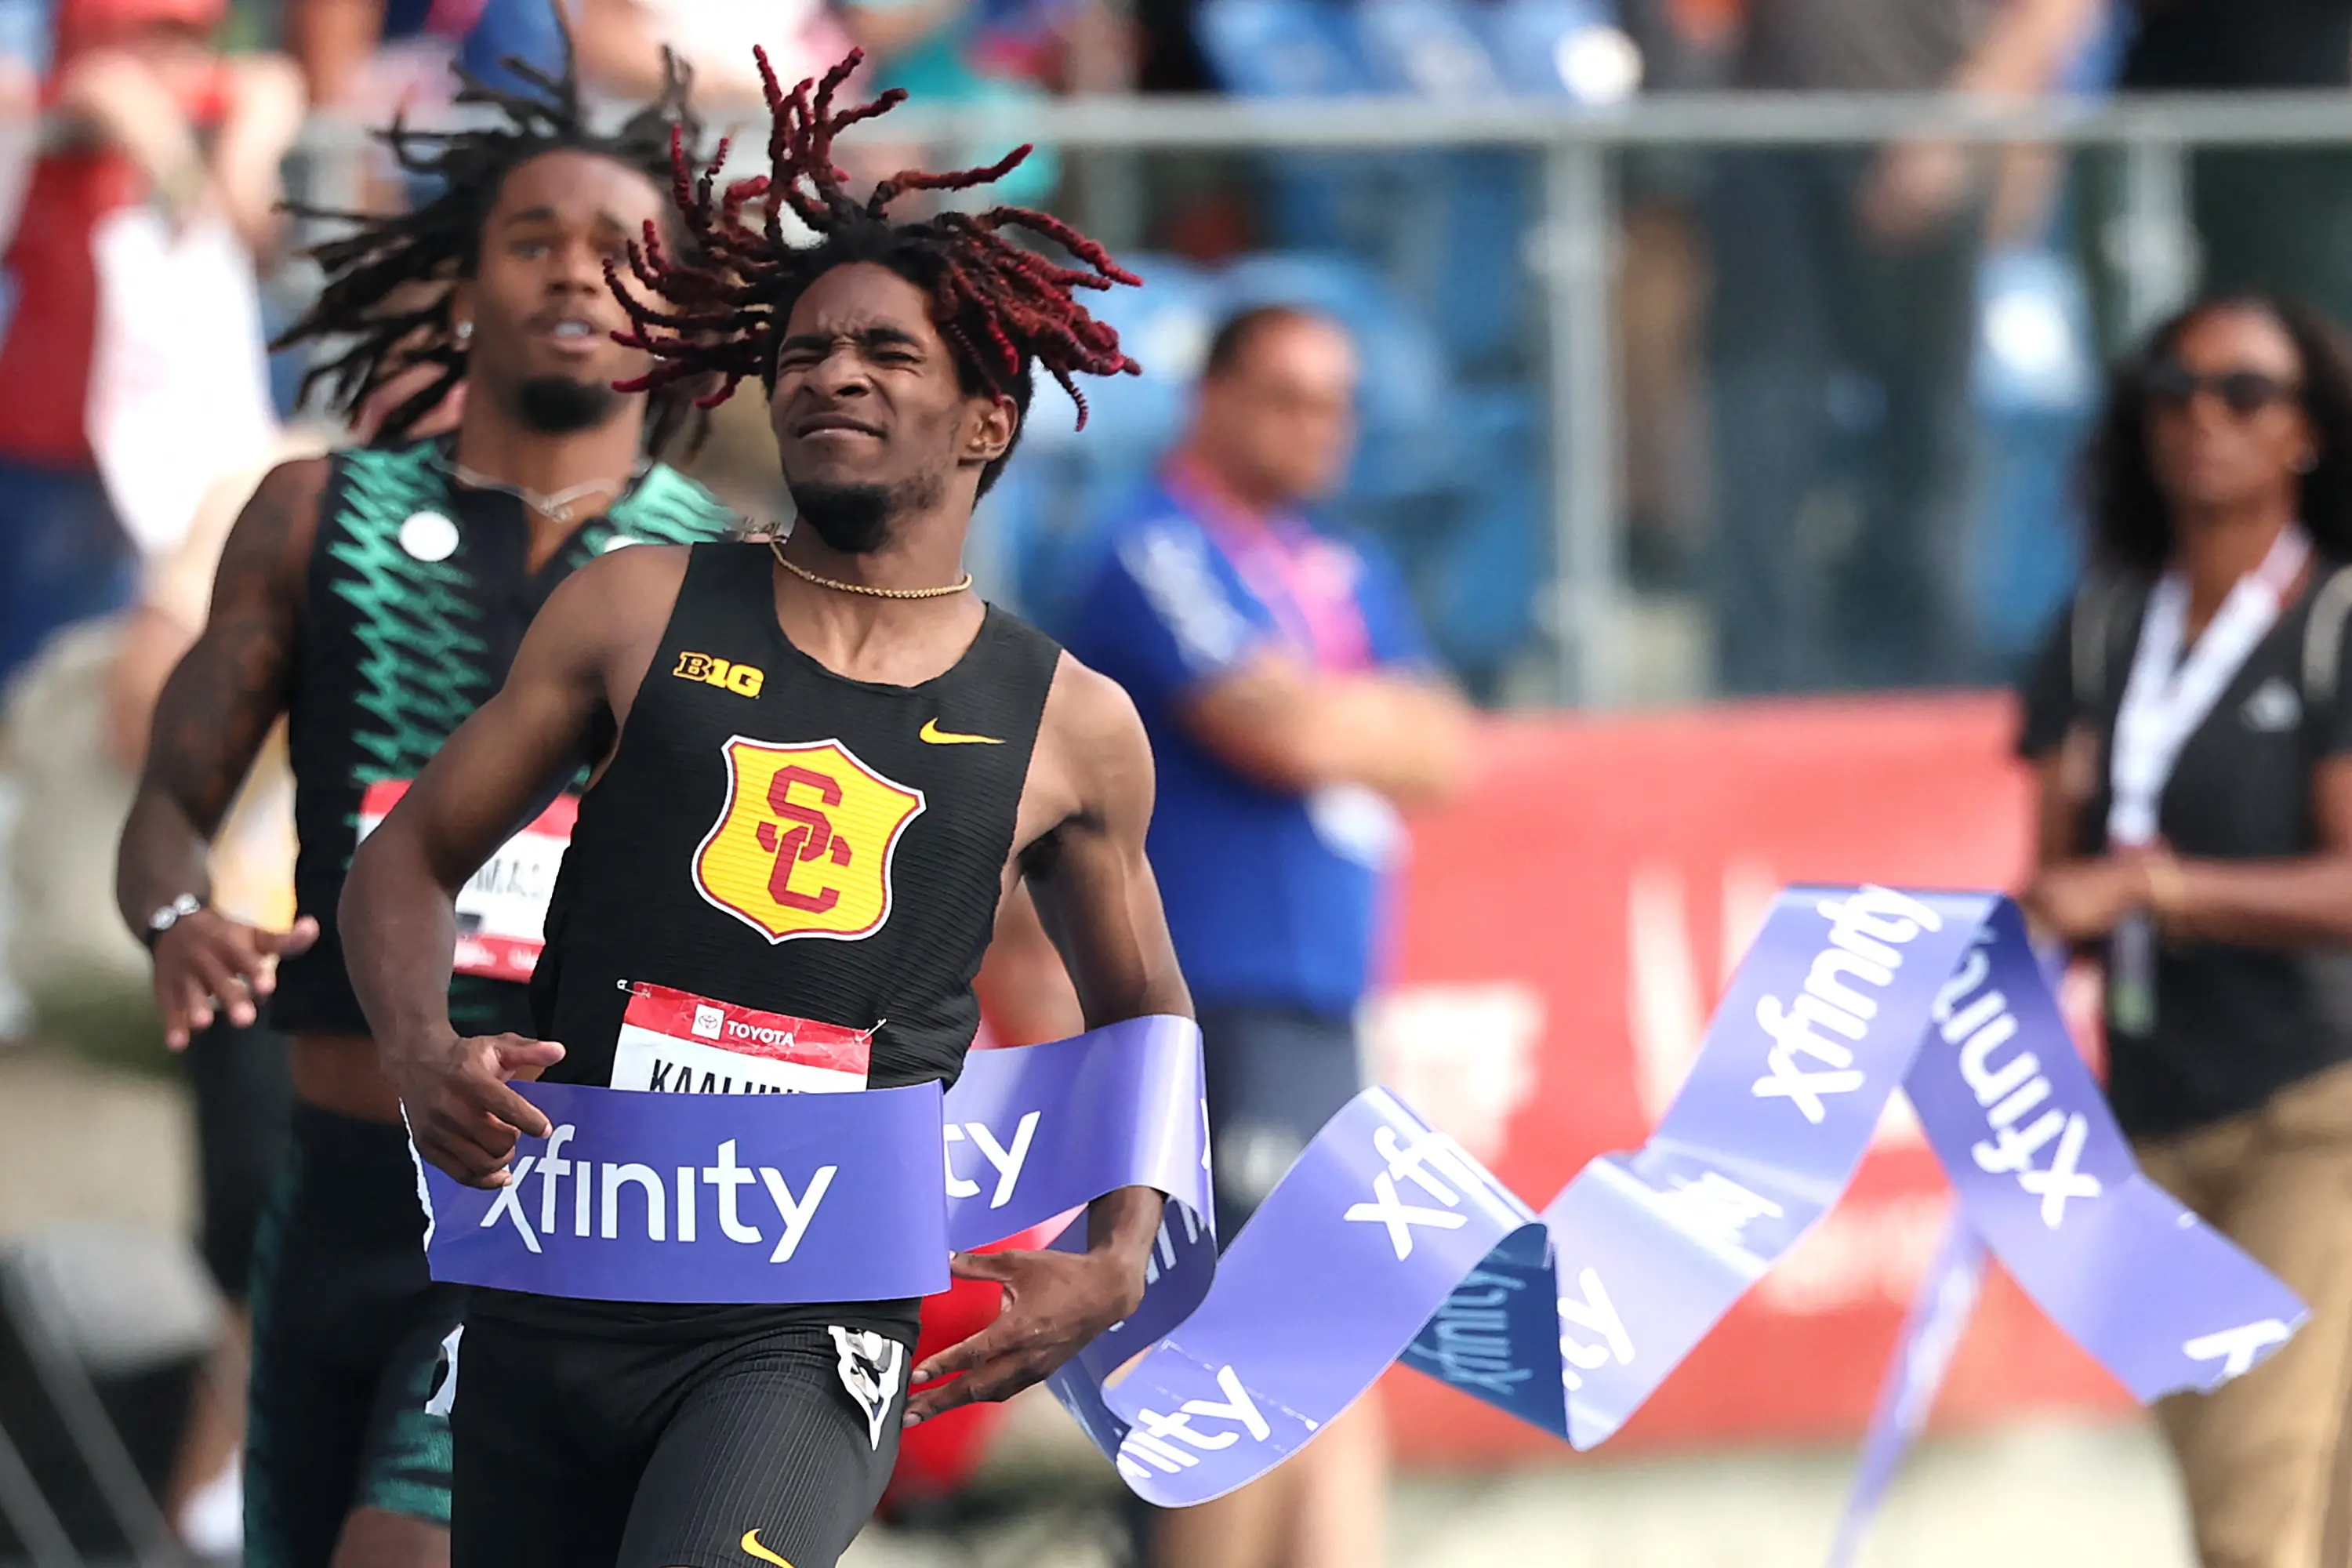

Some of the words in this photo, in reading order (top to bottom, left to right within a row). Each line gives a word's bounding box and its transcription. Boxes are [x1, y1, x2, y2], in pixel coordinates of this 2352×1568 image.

[726, 1020, 796, 1048] TOYOTA
[1751, 884, 1942, 1124] xfinity
[480, 1124, 838, 1264] xfinity
